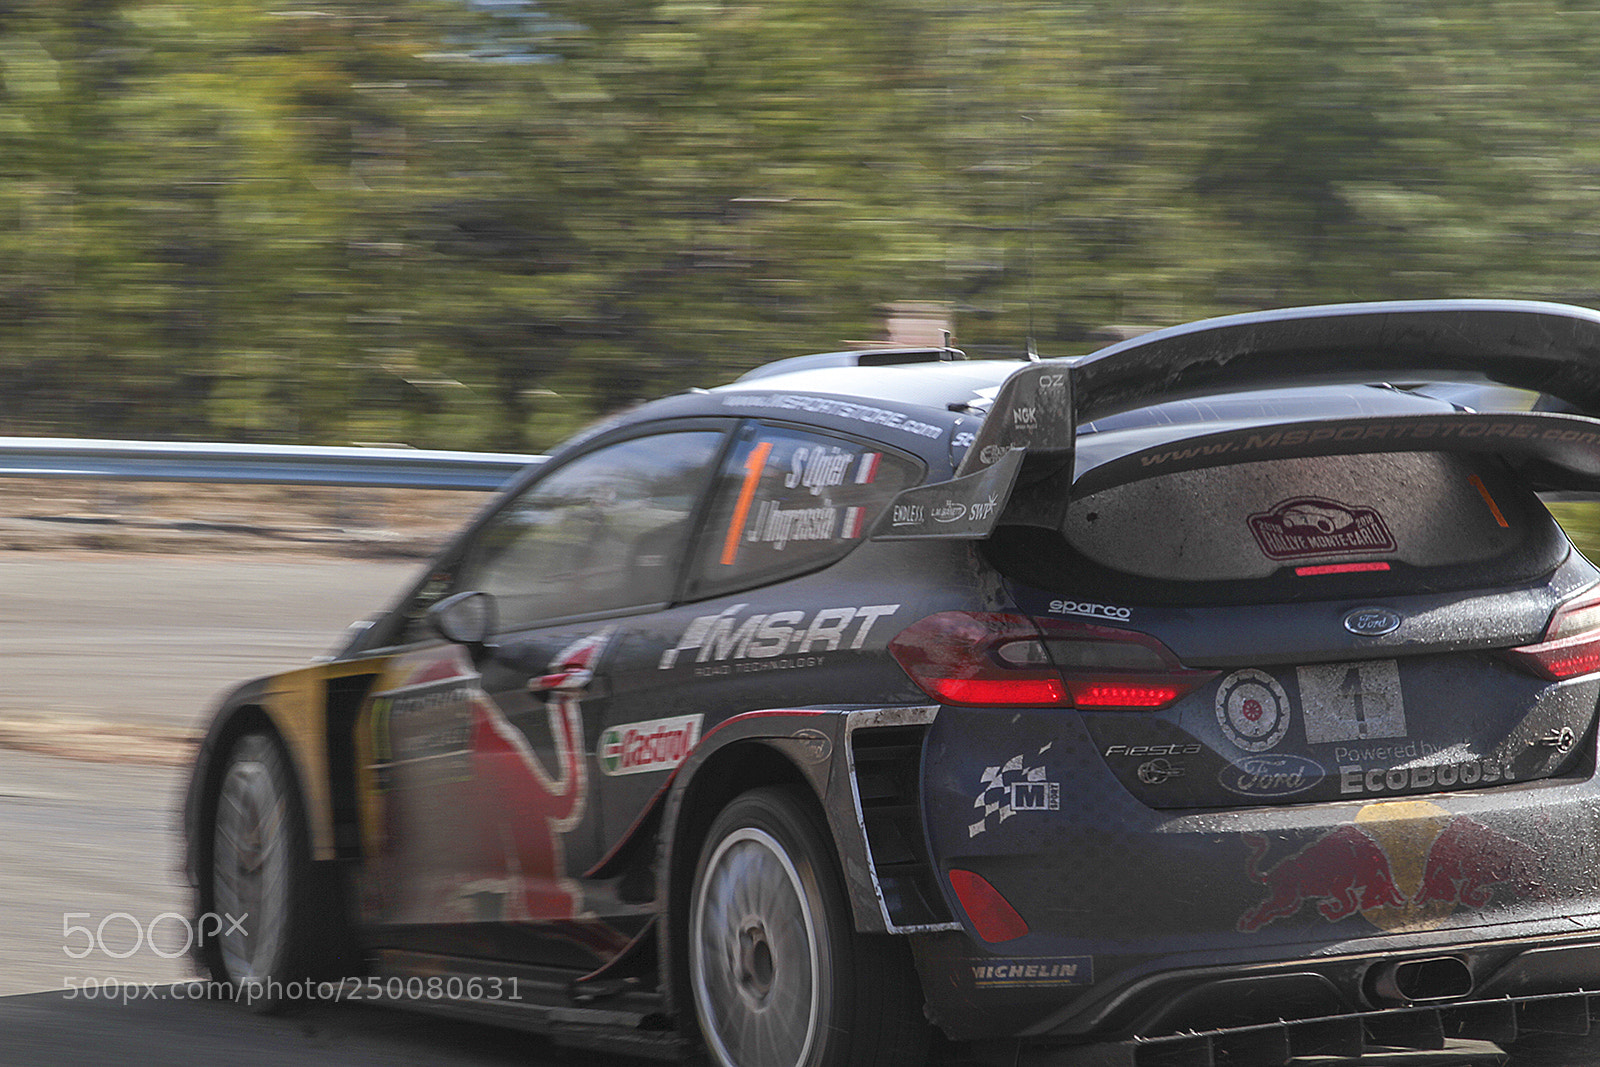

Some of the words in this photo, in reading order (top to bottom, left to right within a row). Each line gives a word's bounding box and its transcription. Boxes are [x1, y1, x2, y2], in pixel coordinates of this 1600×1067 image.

[1039, 374, 1064, 388] OZ
[1012, 407, 1038, 423] NGK
[784, 447, 809, 488] S
[720, 442, 774, 565] 1
[1466, 473, 1509, 527] 1
[969, 503, 993, 520] SWP
[1261, 531, 1308, 552] RALLYE
[1308, 523, 1387, 548] MONTE-CARLO
[1049, 600, 1131, 618] sparco
[1357, 614, 1387, 629] Ford
[736, 656, 825, 674] TECHNOLOGY
[1335, 741, 1416, 763] Powered
[1237, 760, 1306, 790] Ford
[972, 964, 1078, 979] MICHELIN
